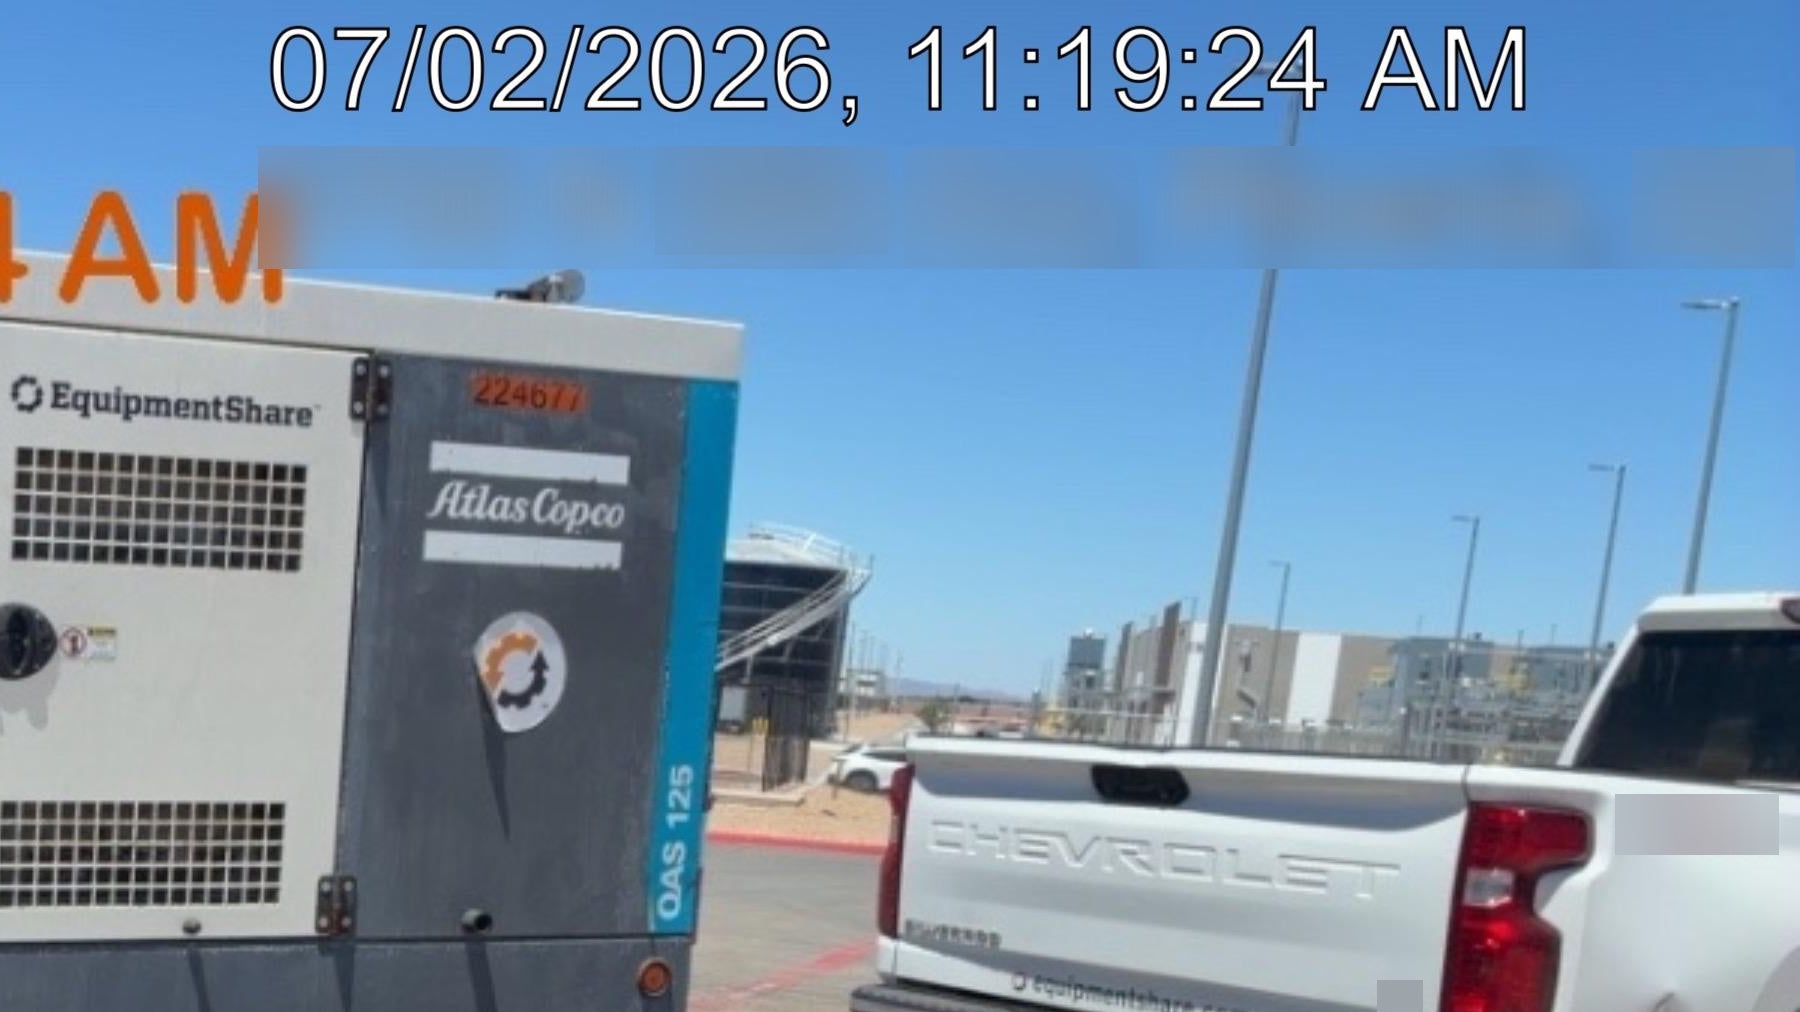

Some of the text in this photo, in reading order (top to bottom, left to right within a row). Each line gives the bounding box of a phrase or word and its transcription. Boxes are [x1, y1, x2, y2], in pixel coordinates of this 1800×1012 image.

[50, 380, 316, 428] EquipmentShare
[472, 375, 584, 411] 224677
[427, 479, 625, 534] Atlas Copco
[665, 763, 695, 830] 125
[928, 818, 1401, 900] CHEVROLET
